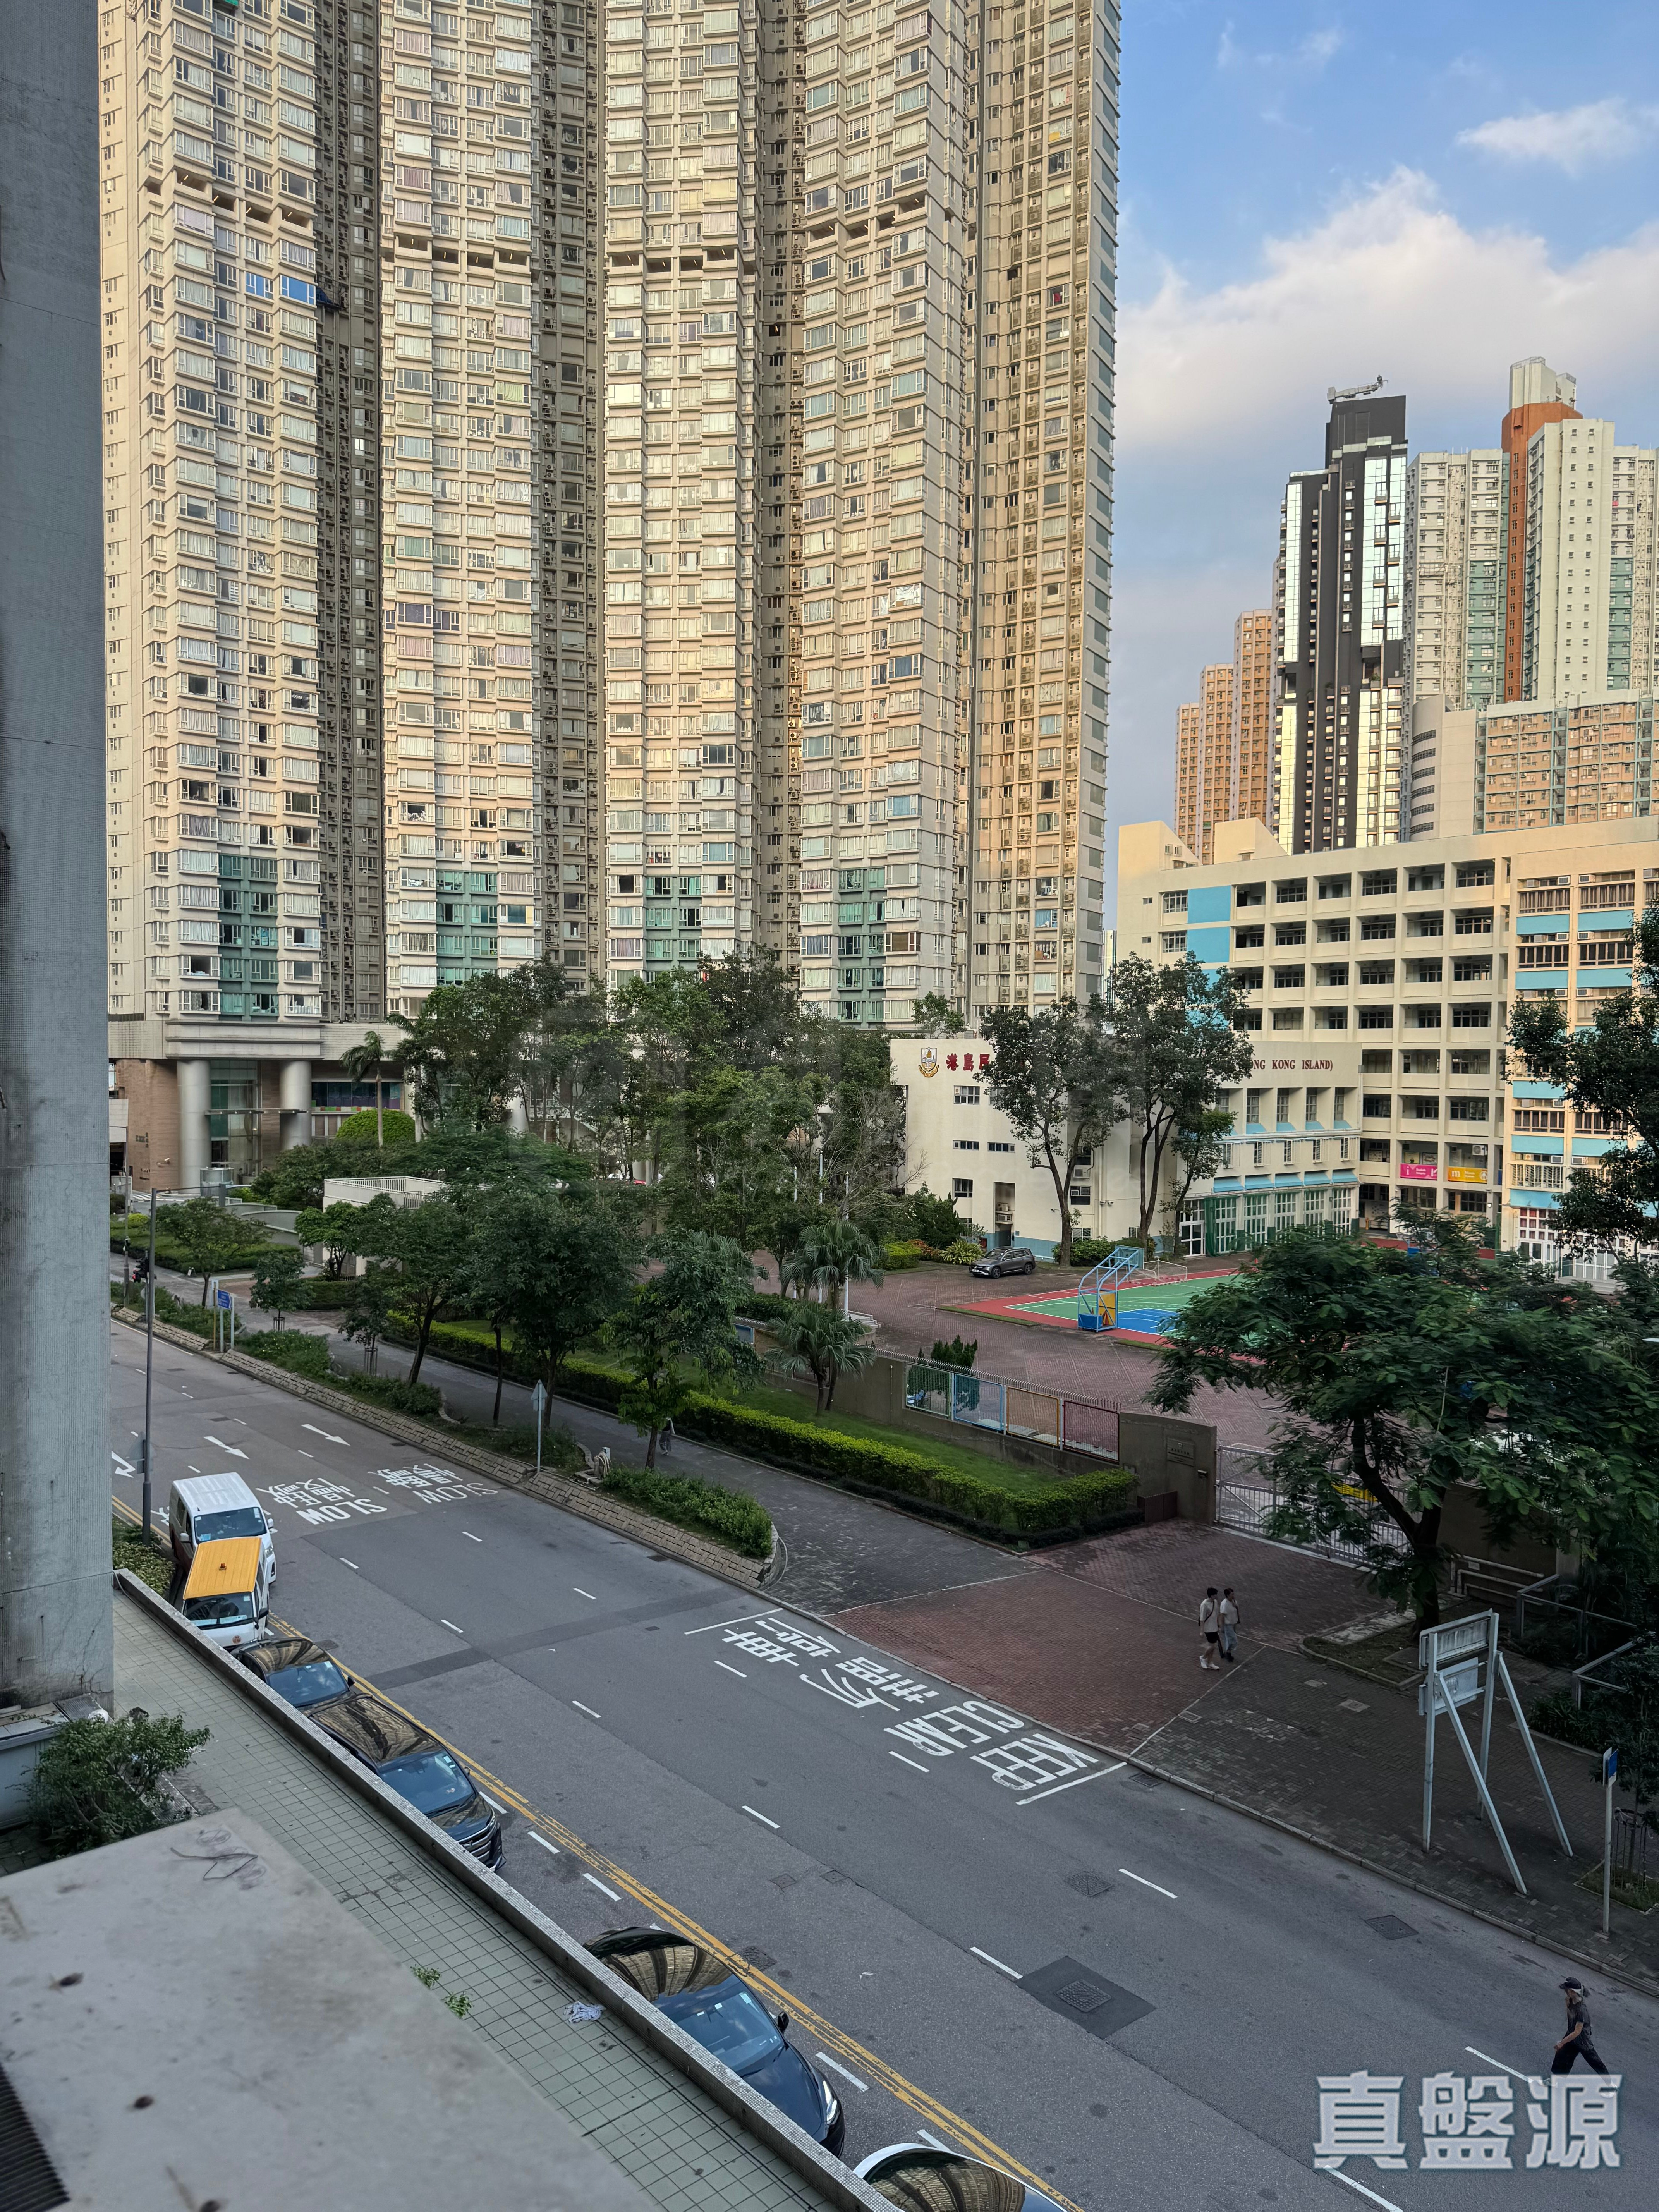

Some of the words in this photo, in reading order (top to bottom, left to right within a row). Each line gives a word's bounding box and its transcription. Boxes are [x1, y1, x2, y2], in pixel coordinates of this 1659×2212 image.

[1272, 1060, 1295, 1070] KONG
[1302, 1060, 1333, 1072] ISLAND)
[368, 1463, 464, 1489] 慢駛
[256, 1477, 356, 1508] 慢駛
[412, 1482, 498, 1504] SLOW
[295, 1499, 388, 1525] SLOW
[723, 1617, 842, 1666] 停車
[800, 1657, 939, 1711] 請勿
[883, 1700, 1024, 1756] CLEAR
[969, 1733, 1099, 1790] KEEP
